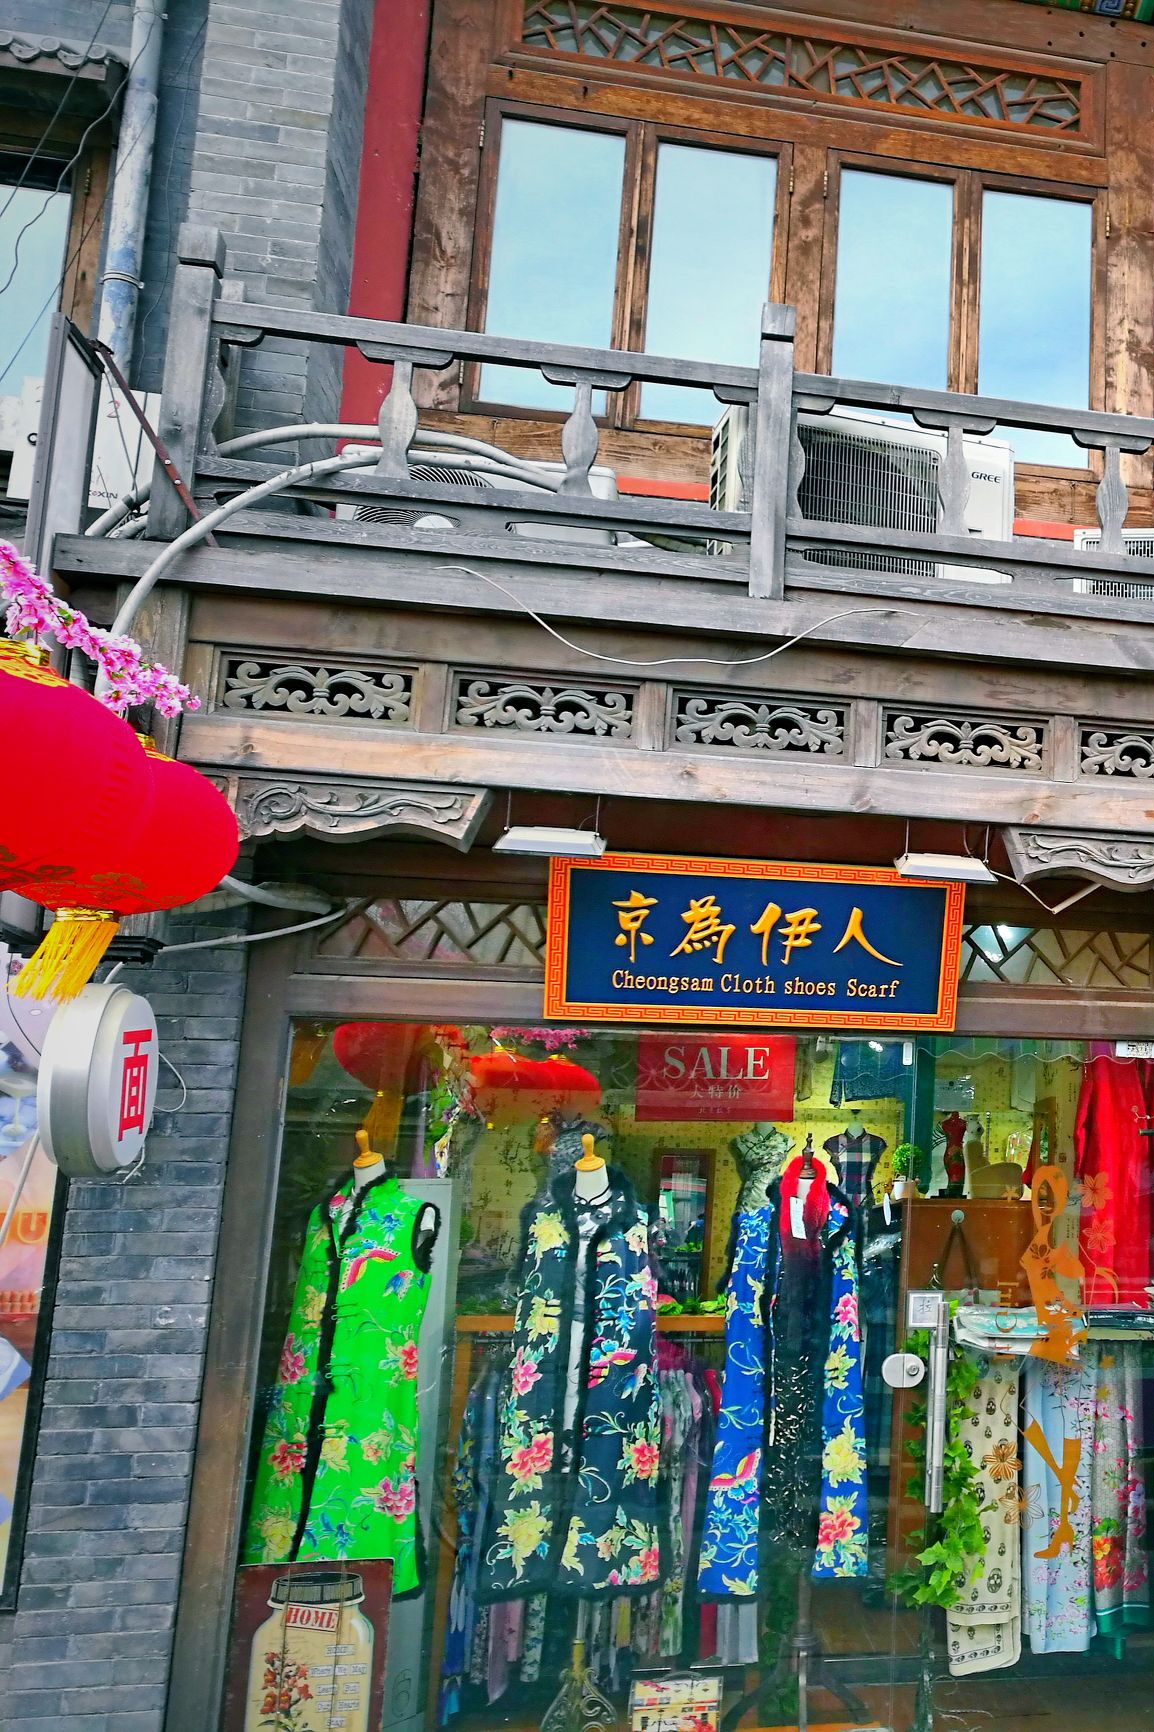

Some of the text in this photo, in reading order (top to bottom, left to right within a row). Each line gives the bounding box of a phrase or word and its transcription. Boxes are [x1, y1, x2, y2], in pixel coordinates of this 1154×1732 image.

[971, 471, 1002, 484] GREE
[611, 889, 904, 967] 京為伊人
[611, 969, 900, 998] Cheongsam Cloth shoes Scarf
[663, 1046, 770, 1080] SALE
[286, 1606, 338, 1630] HOME
